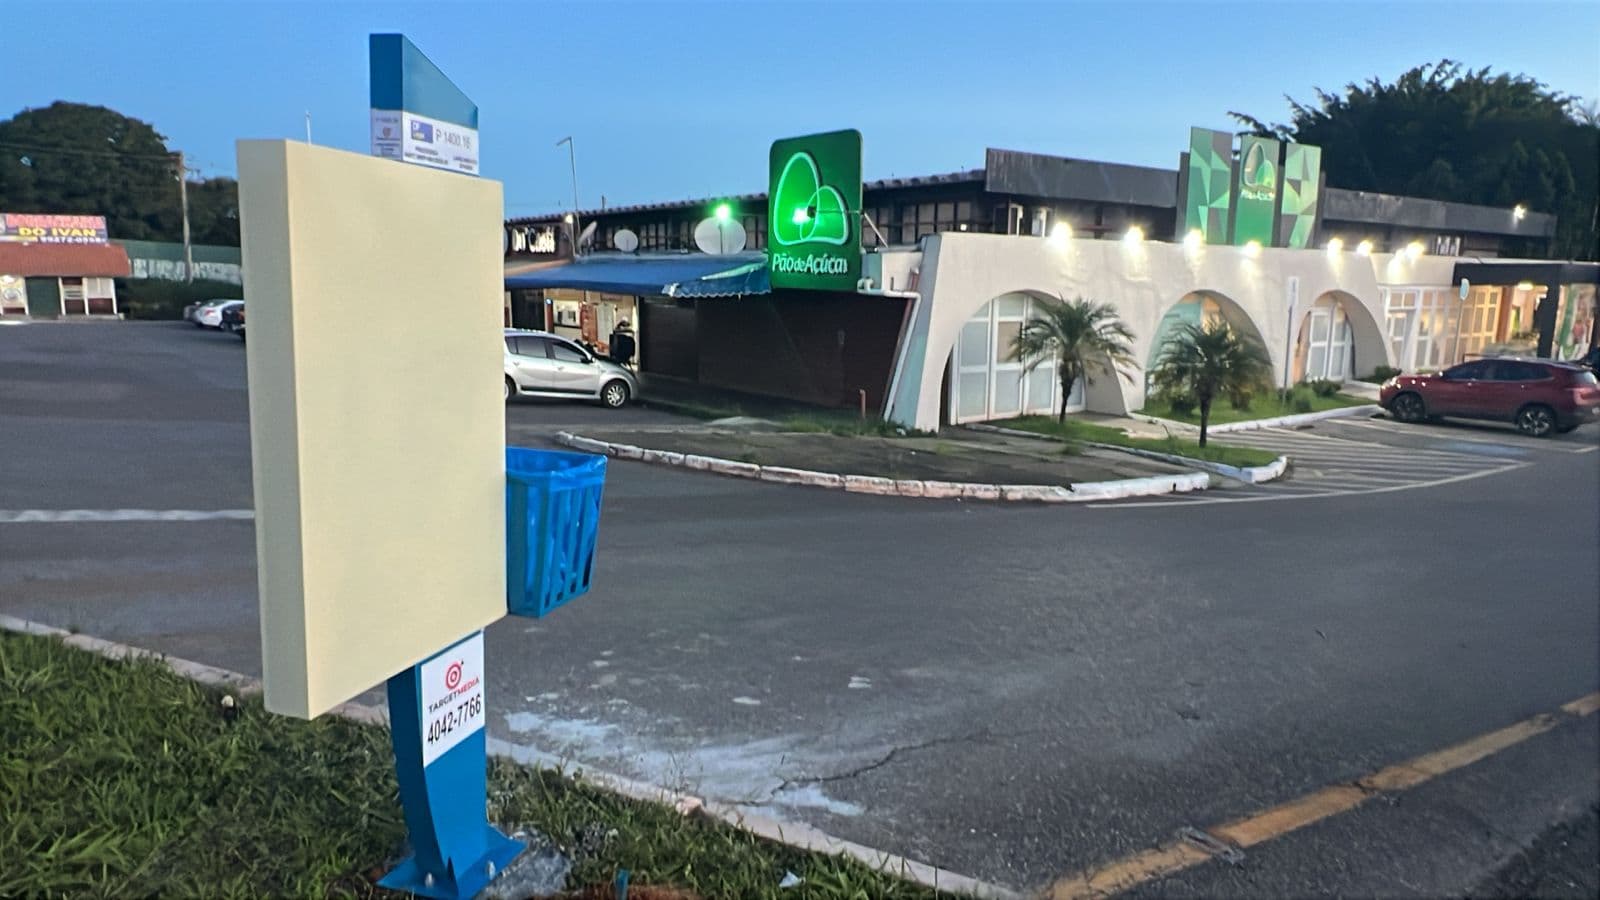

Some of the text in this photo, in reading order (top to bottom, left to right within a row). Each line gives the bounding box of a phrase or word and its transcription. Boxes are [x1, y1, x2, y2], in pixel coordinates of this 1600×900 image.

[18, 227, 97, 238] DO IVAN
[428, 677, 480, 713] TARGETMEDIA
[427, 693, 481, 745] 4042-7766
